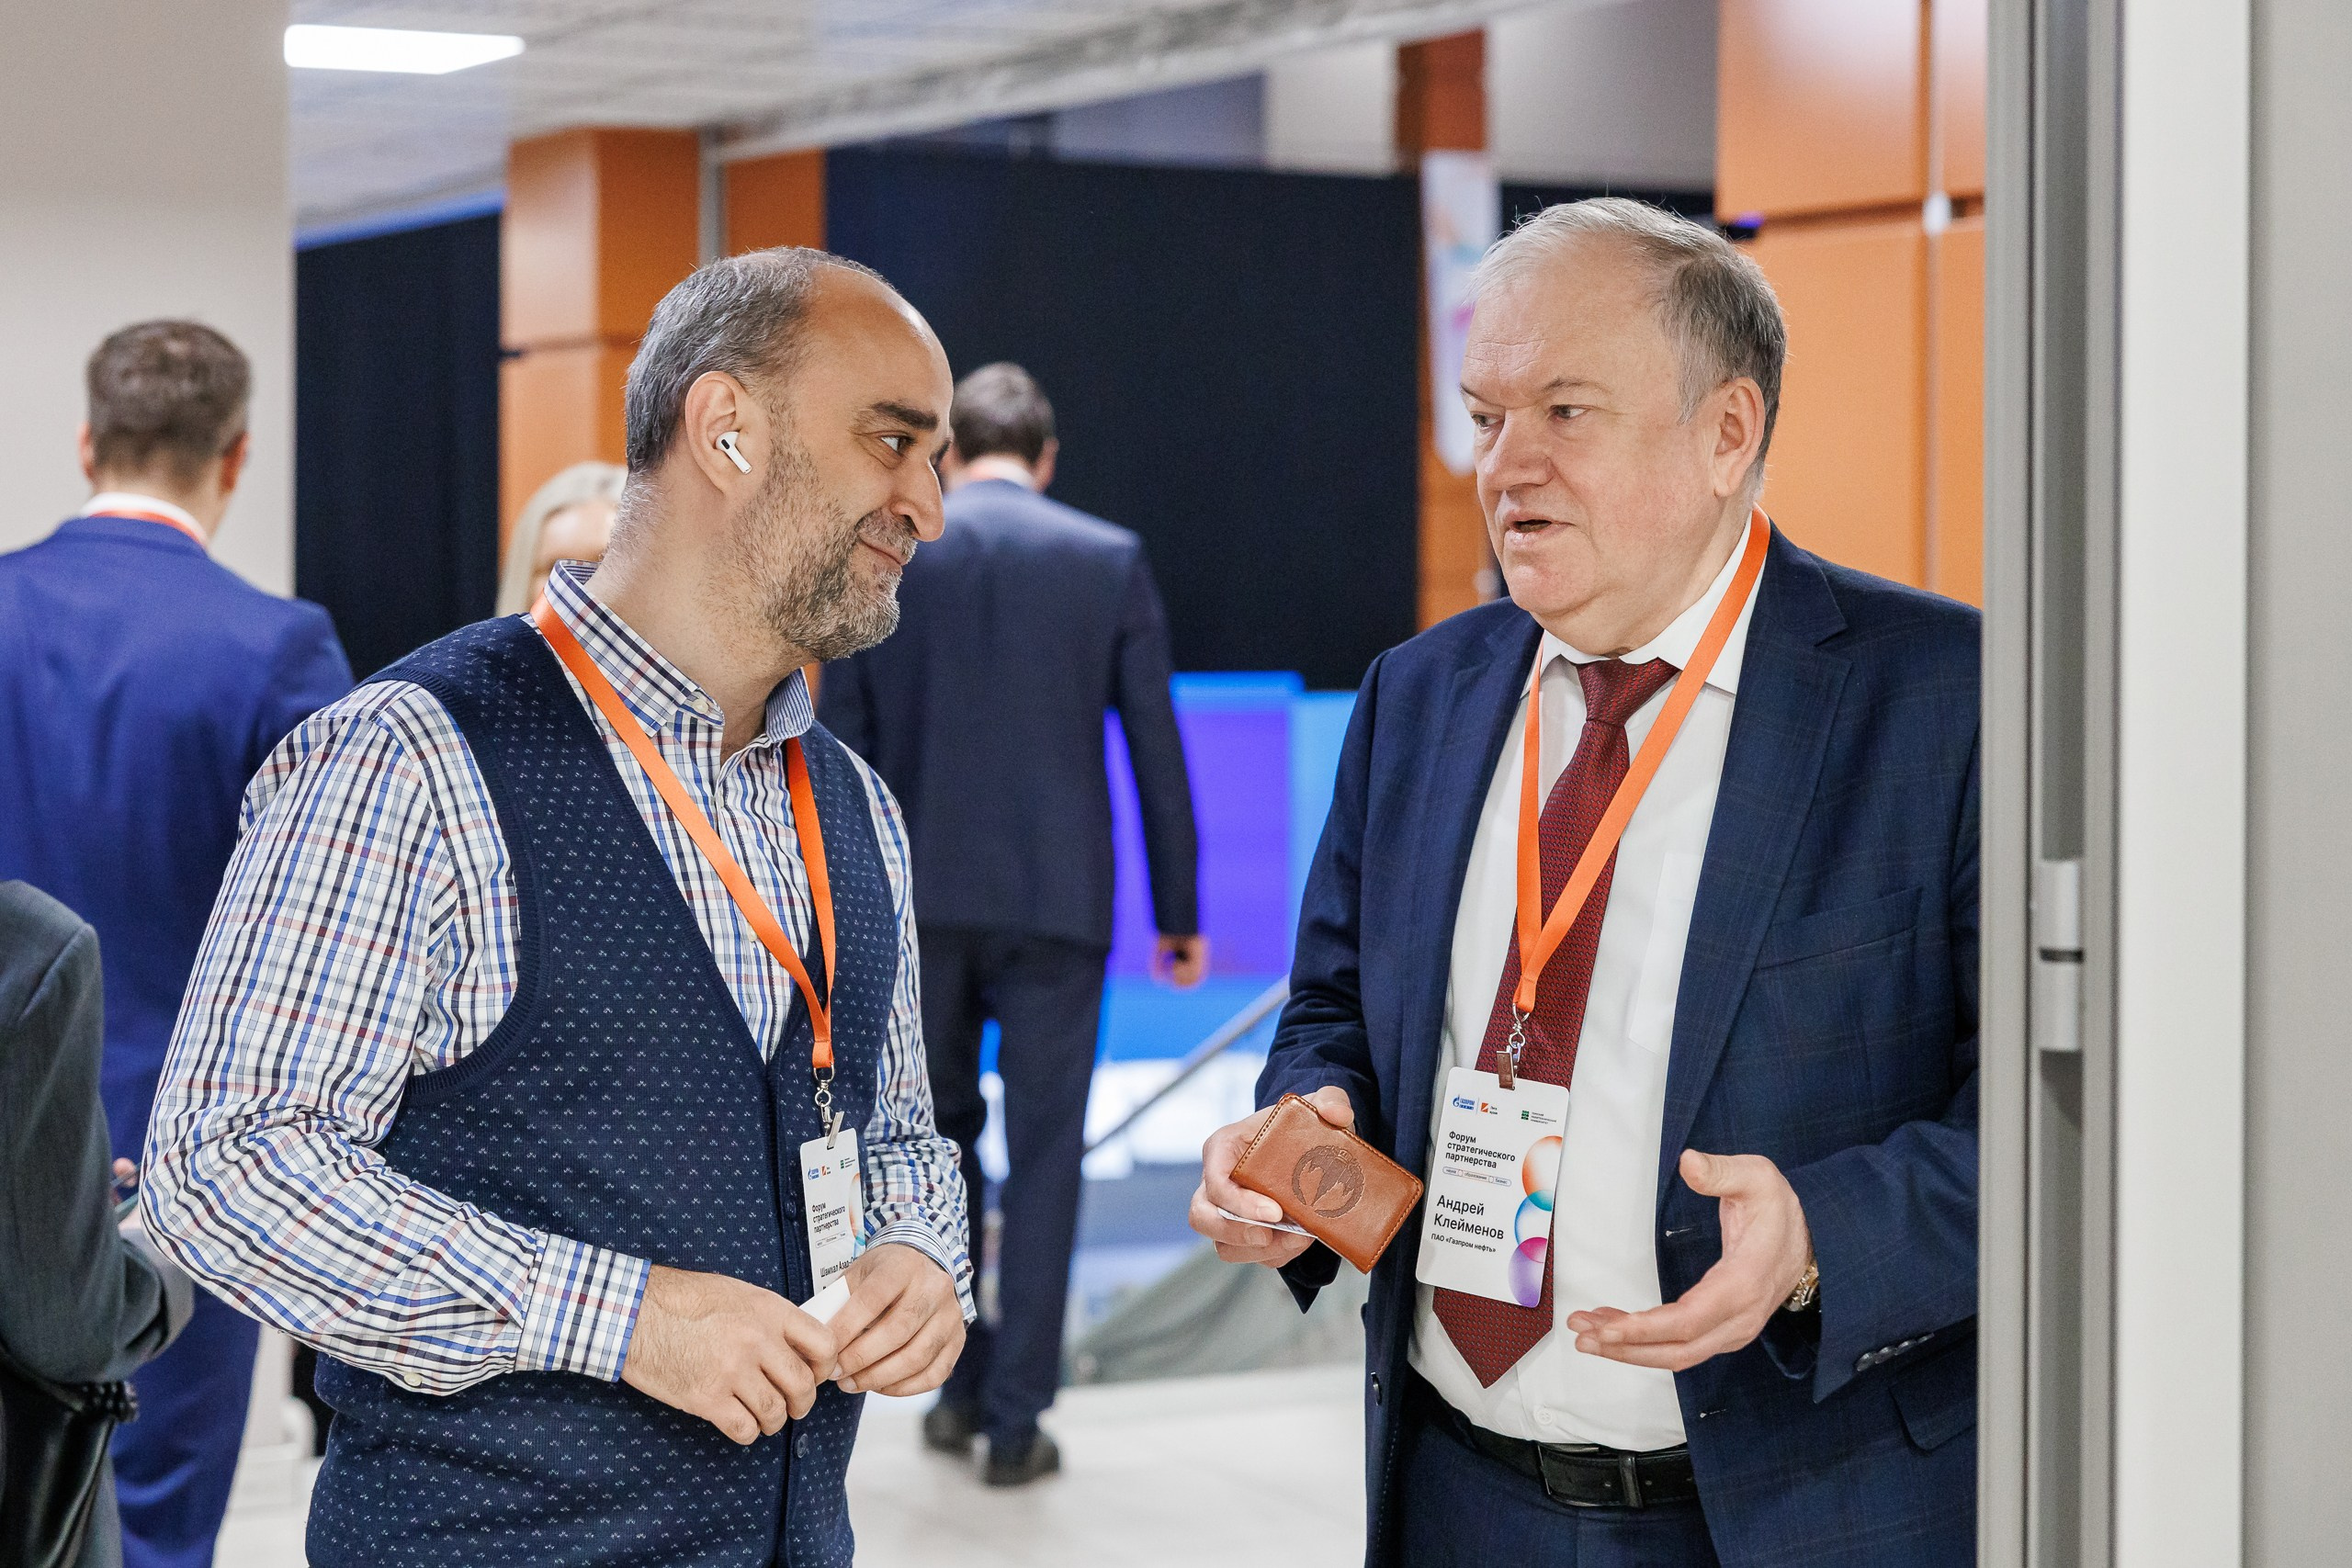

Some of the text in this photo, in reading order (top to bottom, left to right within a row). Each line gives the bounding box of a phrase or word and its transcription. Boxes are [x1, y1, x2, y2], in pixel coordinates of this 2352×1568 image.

[1449, 1131, 1476, 1144] Форум
[1445, 1151, 1498, 1169] партнерства
[1447, 1141, 1516, 1162] стратегического
[811, 1202, 827, 1213] Форум
[1436, 1194, 1485, 1216] Андрей
[1433, 1213, 1505, 1240] Клейменов
[1430, 1233, 1497, 1253] ПАО «Газпром нефть»
